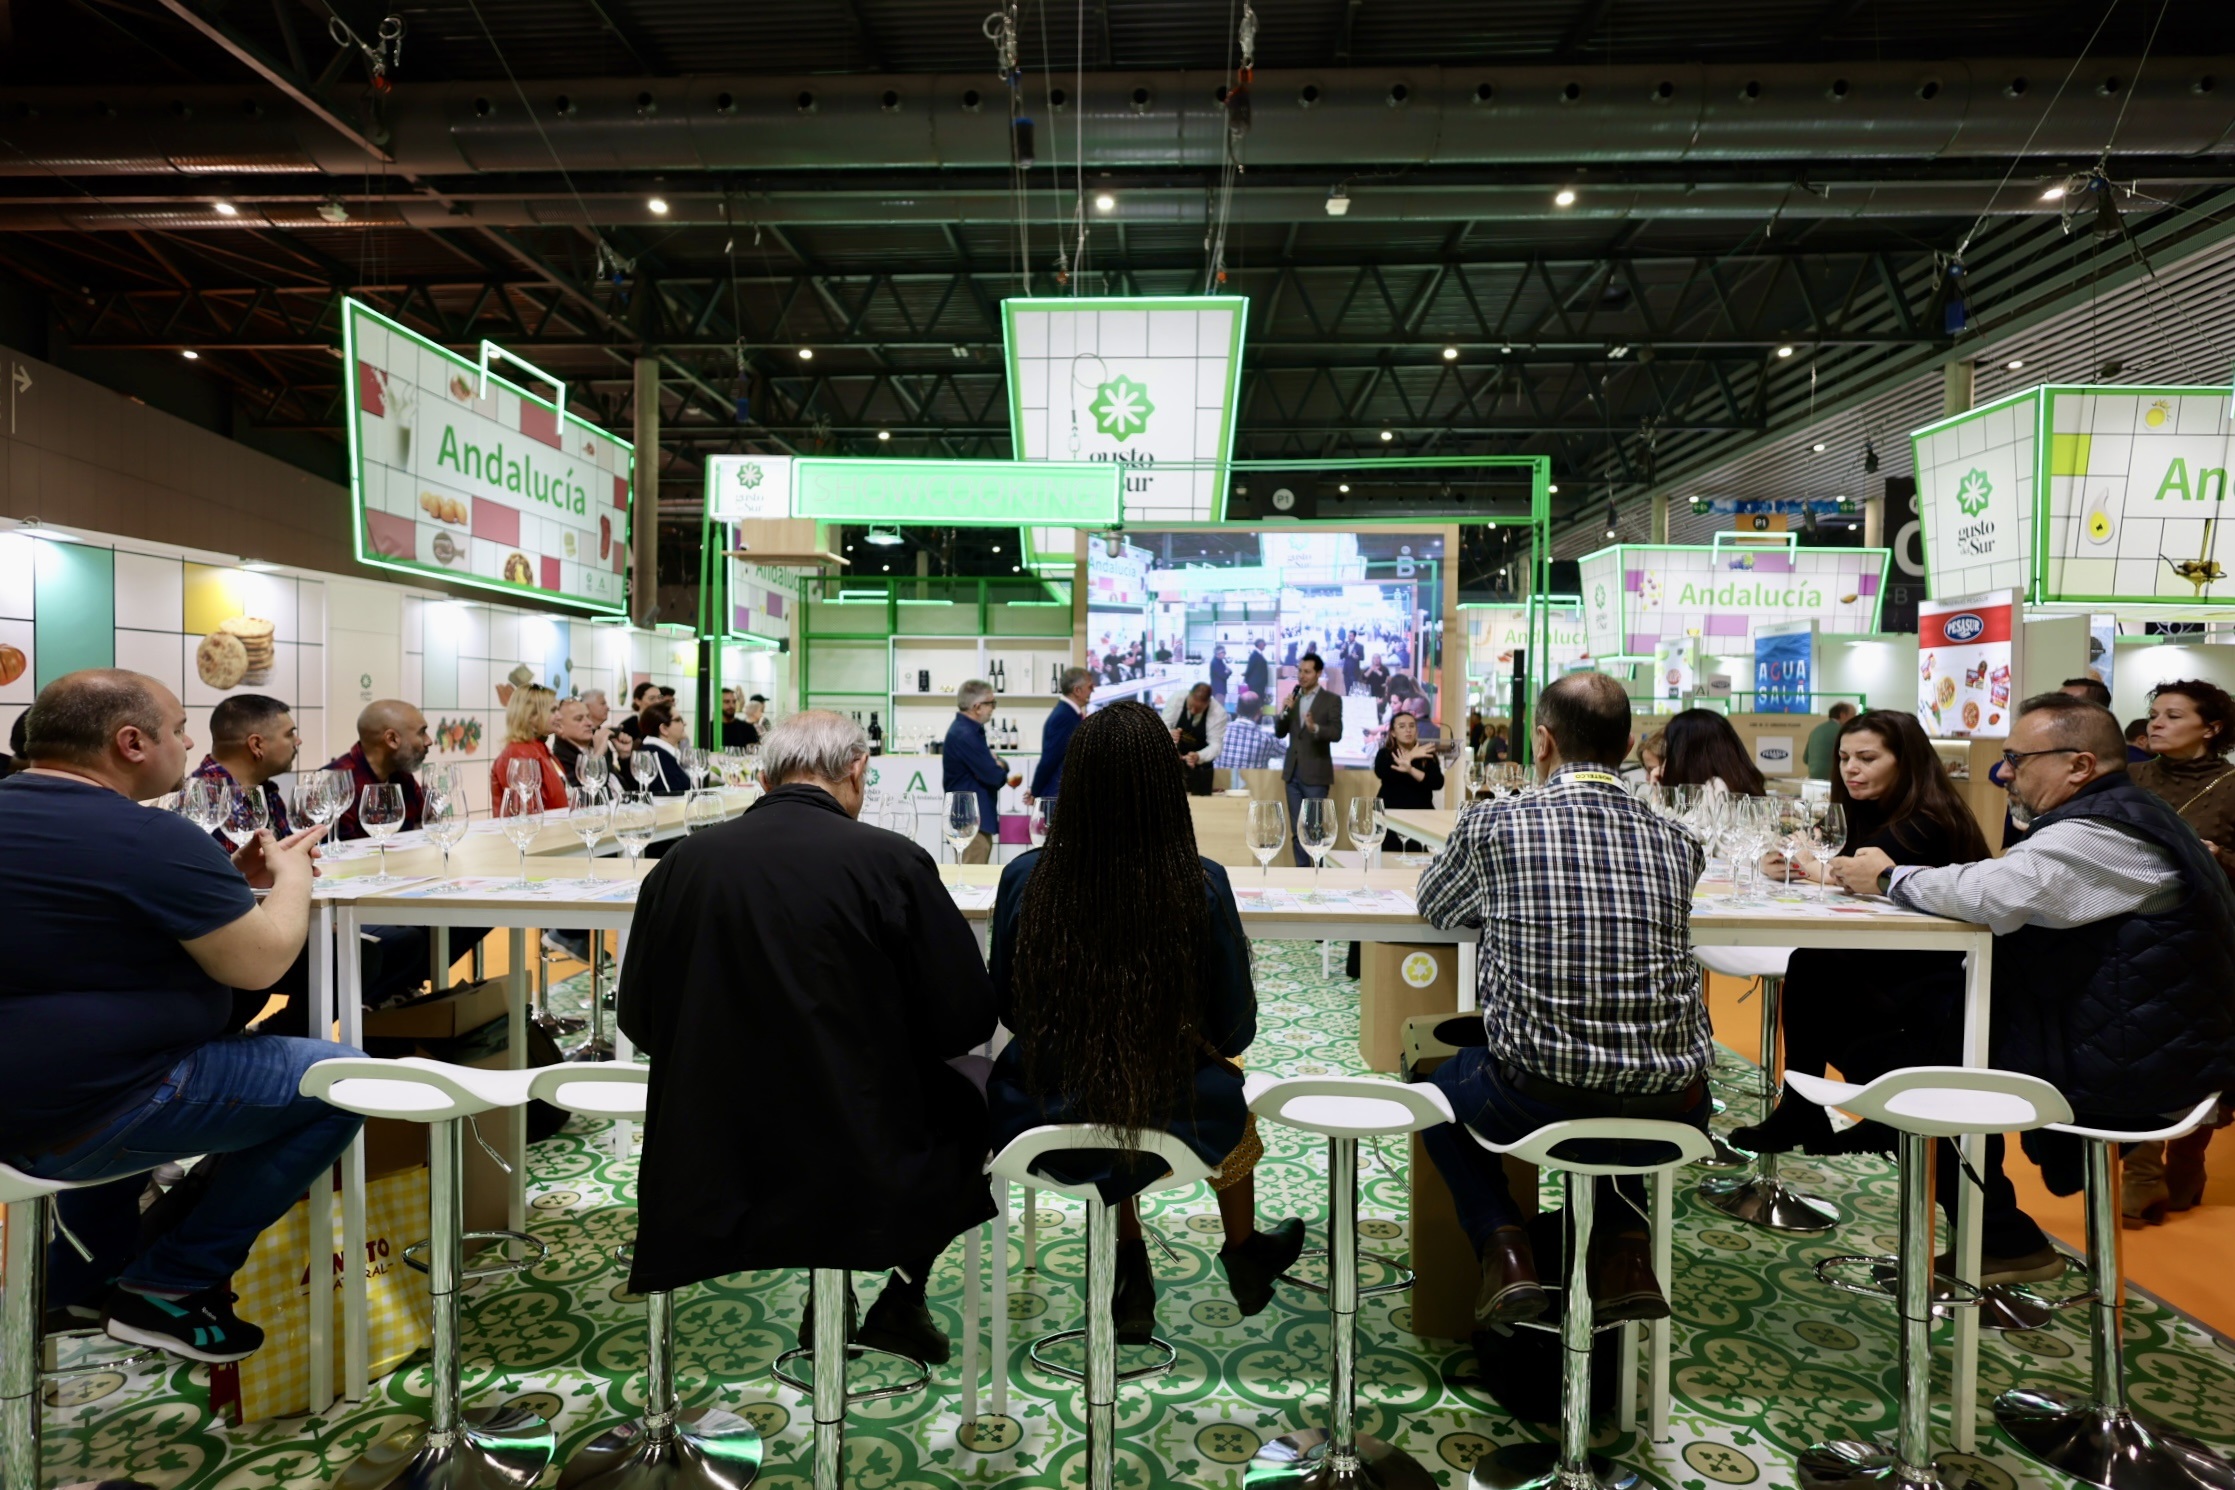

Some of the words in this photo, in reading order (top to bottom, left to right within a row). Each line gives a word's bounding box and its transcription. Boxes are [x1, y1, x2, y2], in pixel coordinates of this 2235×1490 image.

[437, 424, 587, 517] Andalucía
[1124, 473, 1154, 493] ur
[2154, 457, 2235, 501] An
[814, 472, 1098, 508] SHOWCOOKING
[1957, 519, 1995, 547] gusto
[1970, 537, 1996, 556] Sur
[1679, 580, 1822, 608] Andalucía
[1894, 587, 1909, 605] B
[1946, 618, 1981, 636] PESASUR
[1758, 659, 1807, 682] AGUA
